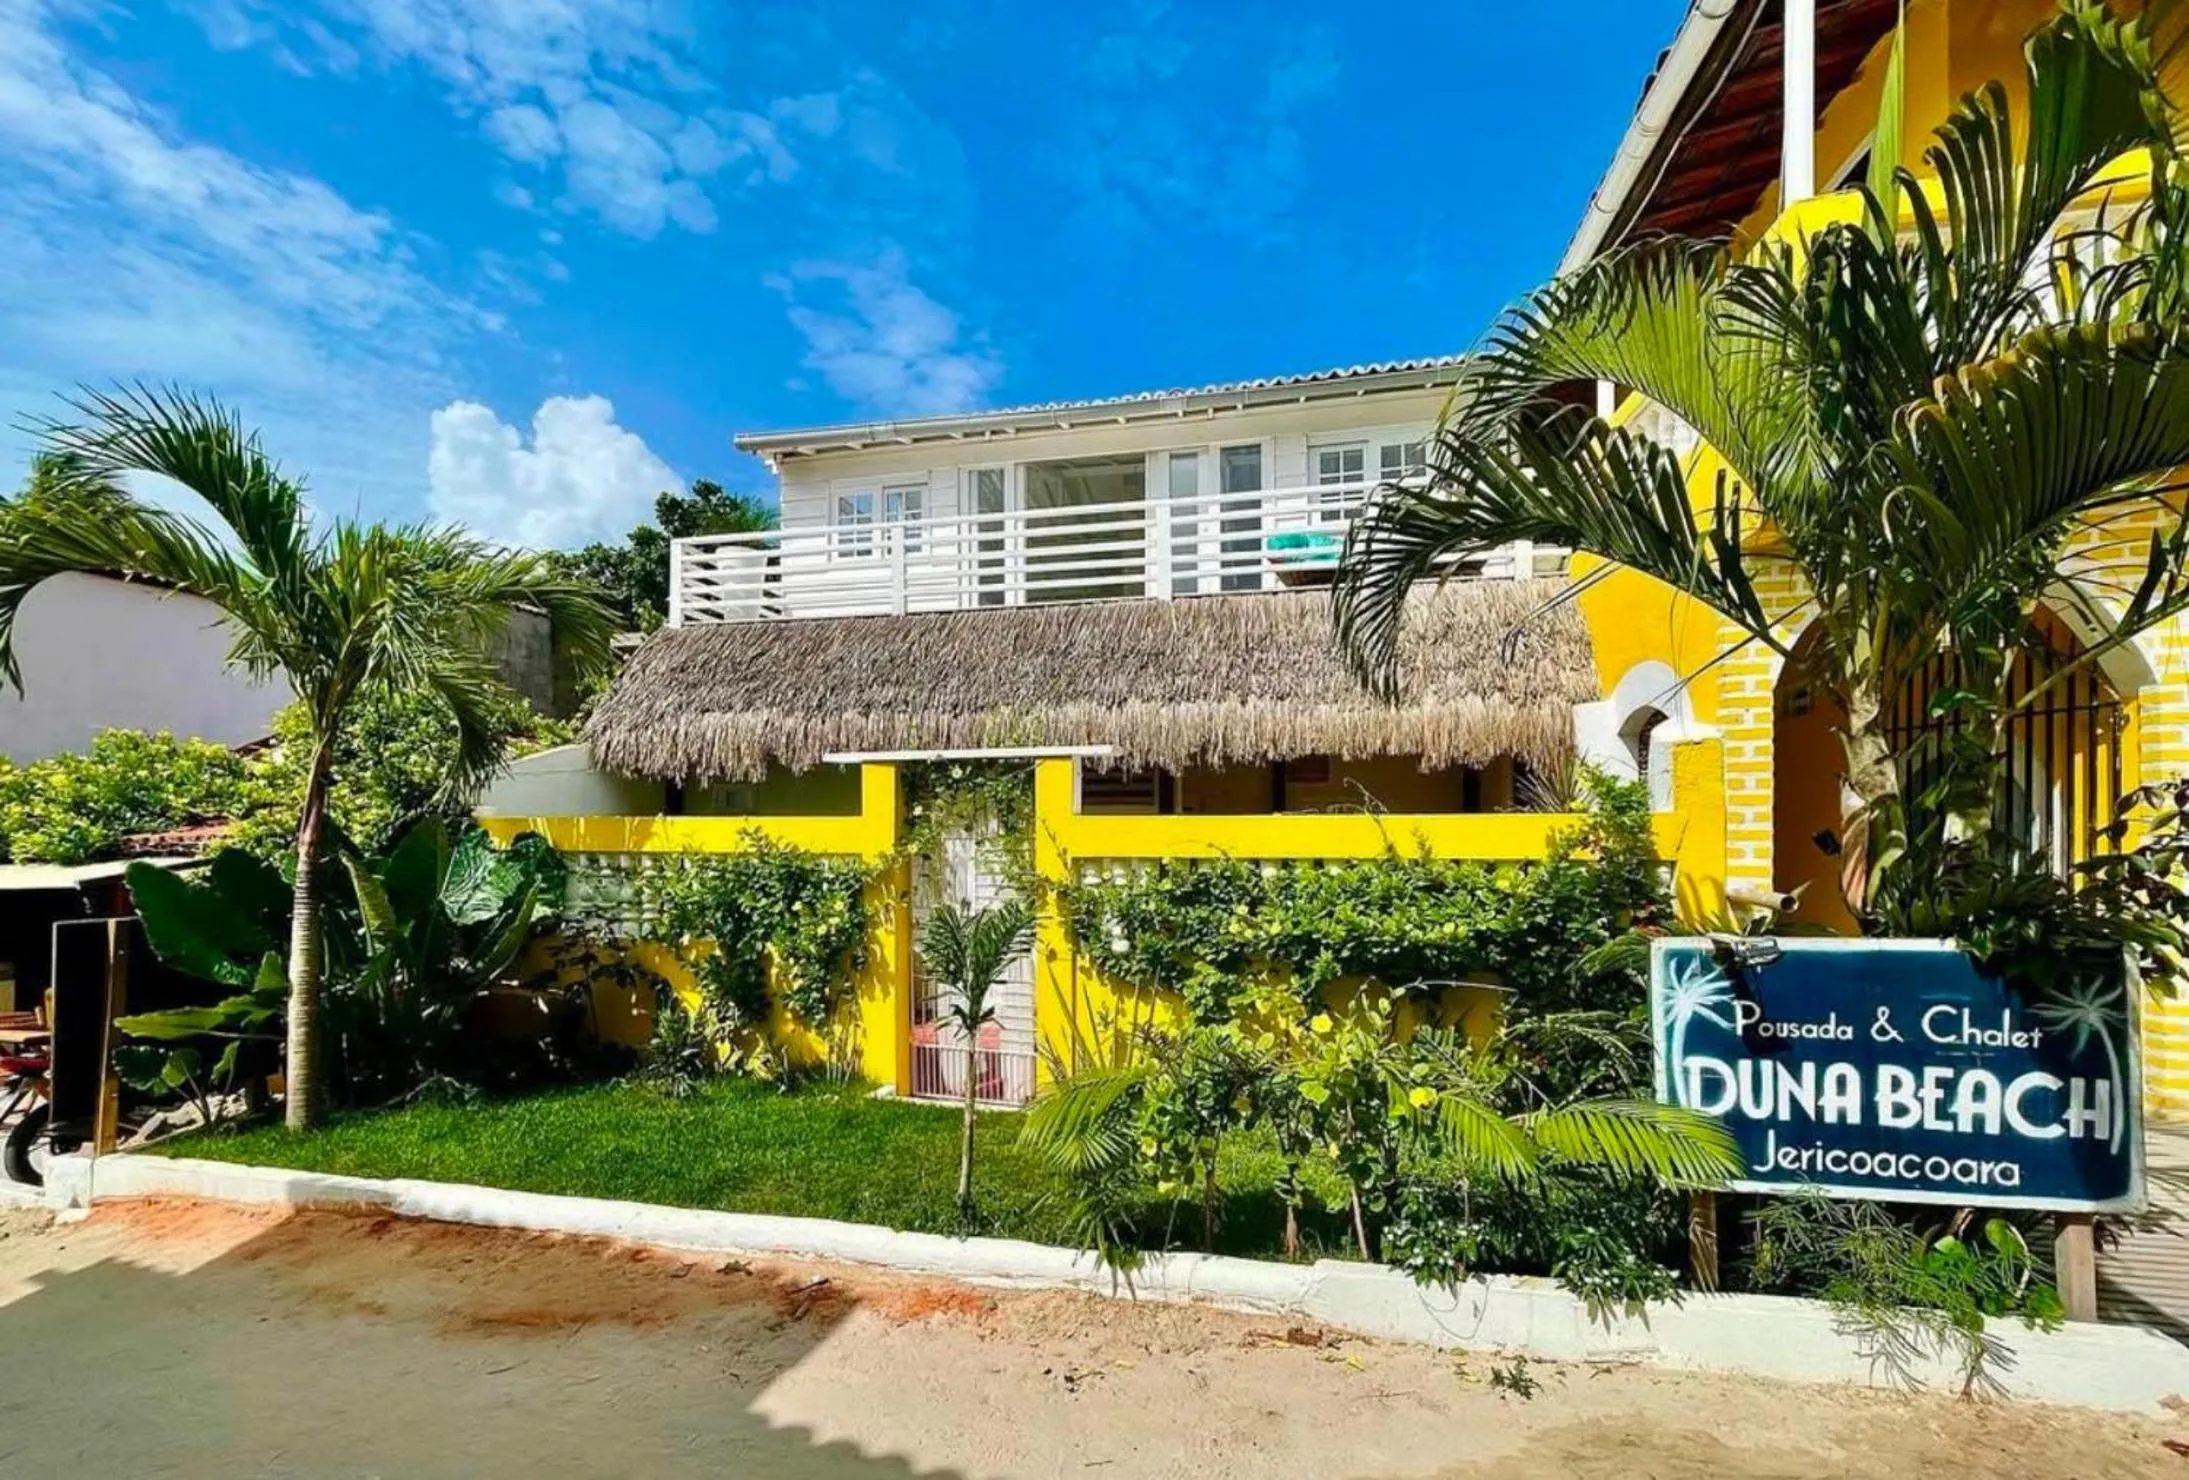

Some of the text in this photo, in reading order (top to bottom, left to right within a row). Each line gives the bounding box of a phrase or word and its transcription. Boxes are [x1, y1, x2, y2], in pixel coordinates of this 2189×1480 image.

[1732, 1000, 2044, 1049] Pousada & Chalet
[1683, 1057, 2112, 1141] DUNA BEACH
[1753, 1129, 2022, 1187] Jericoacoara
